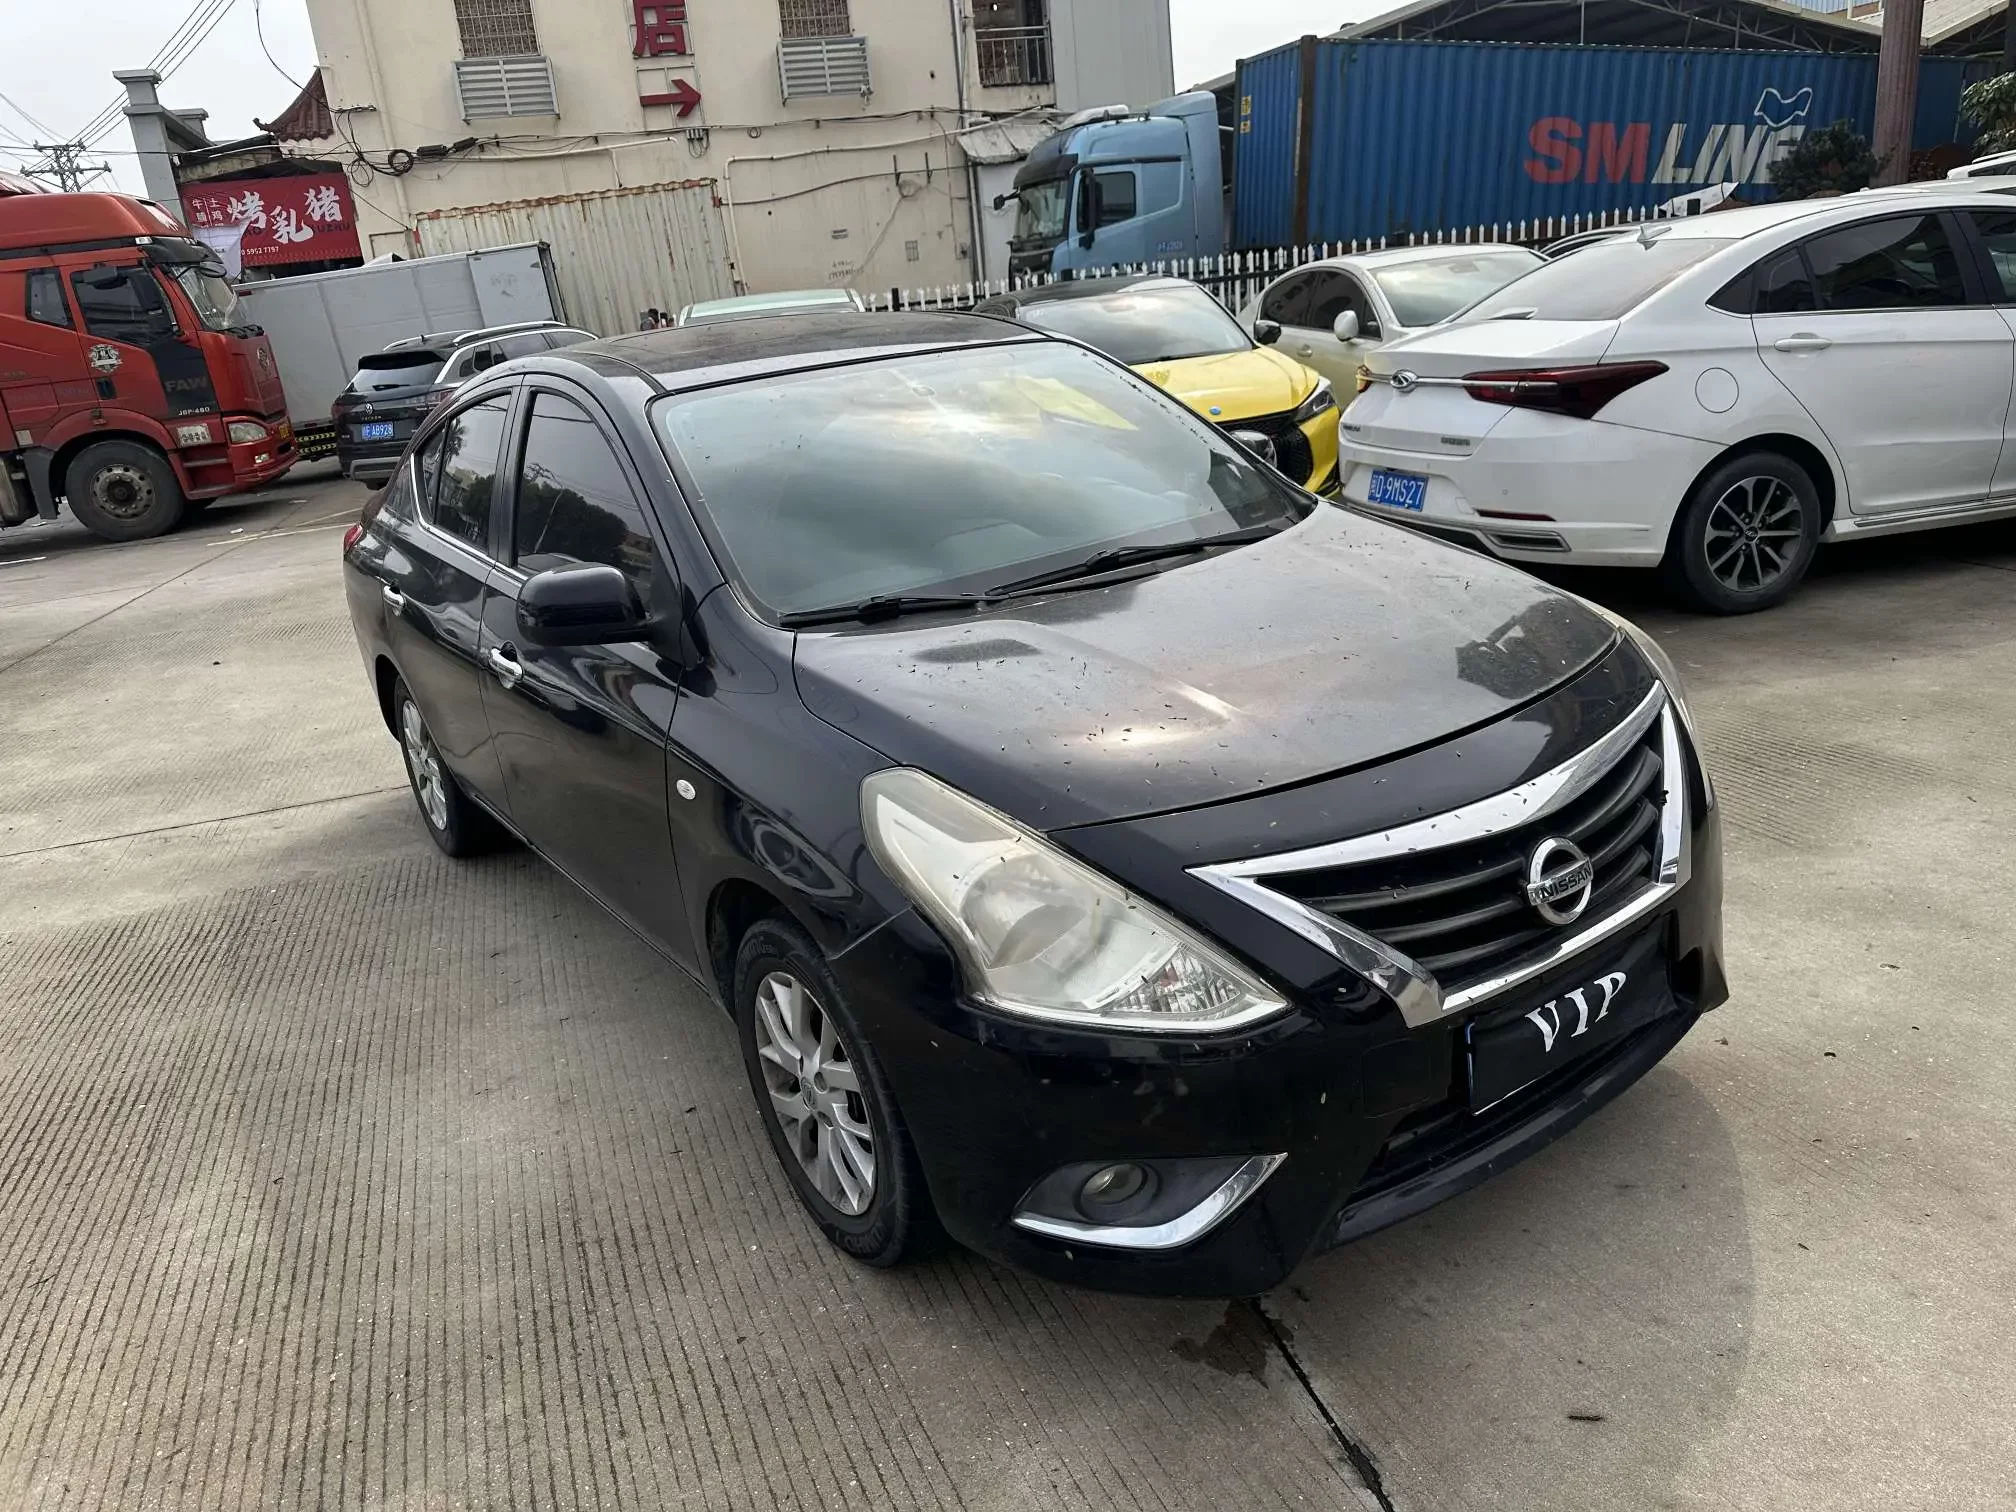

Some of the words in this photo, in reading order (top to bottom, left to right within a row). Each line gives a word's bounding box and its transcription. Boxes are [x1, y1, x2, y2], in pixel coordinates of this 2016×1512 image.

[633, 0, 687, 57] 店
[1524, 116, 1651, 184] SM
[227, 185, 343, 244] 烤乳猪
[165, 376, 208, 392] FAW
[1540, 863, 1592, 899] NISSAN
[1525, 971, 1627, 1053] VIP
